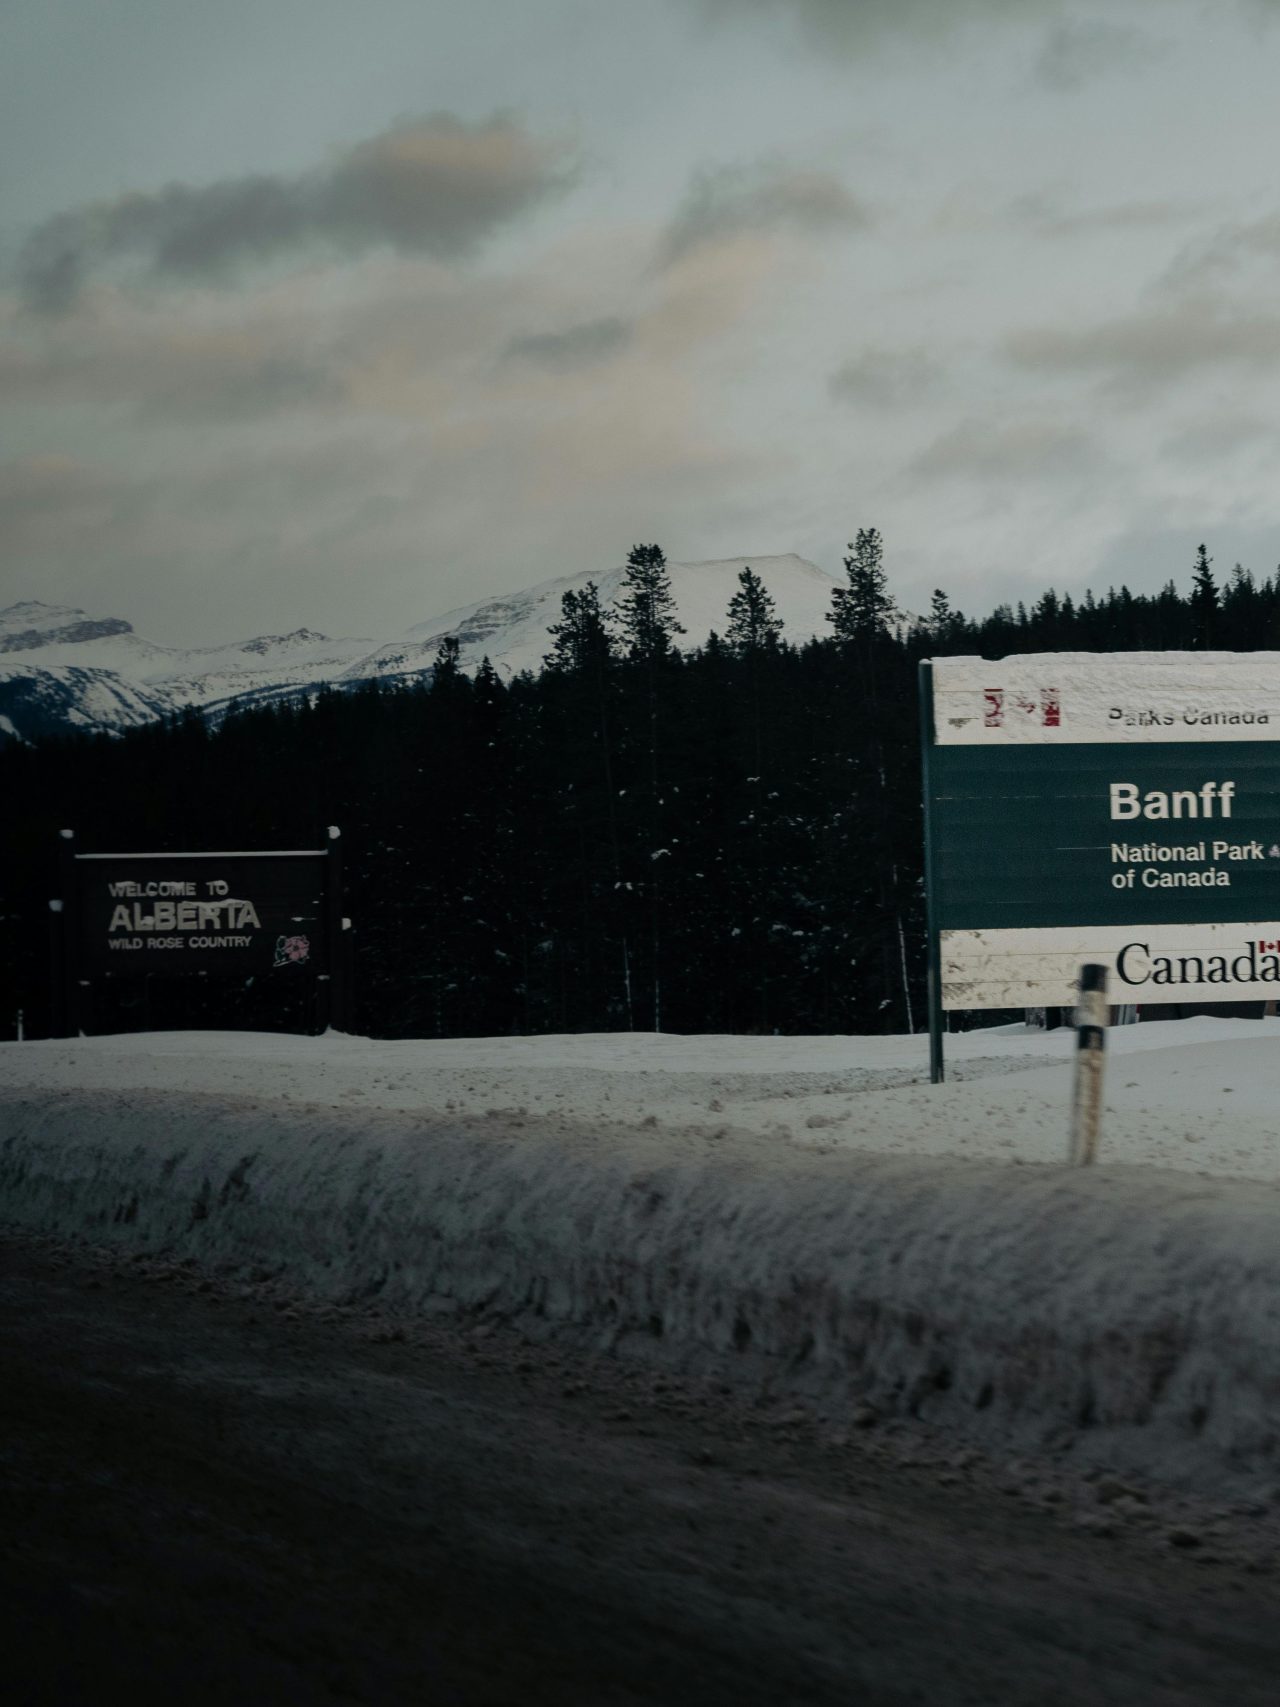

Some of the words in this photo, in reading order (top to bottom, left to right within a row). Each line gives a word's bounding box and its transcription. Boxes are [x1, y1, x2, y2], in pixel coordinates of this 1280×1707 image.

[1109, 781, 1236, 820] Banff
[1110, 841, 1206, 863] National
[1213, 840, 1265, 861] Park
[108, 880, 197, 898] WELCOME
[206, 879, 229, 896] TO
[1111, 868, 1135, 889] of
[1142, 867, 1231, 888] Canada
[108, 898, 262, 932] ALBERTA
[108, 938, 143, 950] WILD
[147, 937, 185, 949] ROSE
[189, 935, 253, 949] COUNTRY
